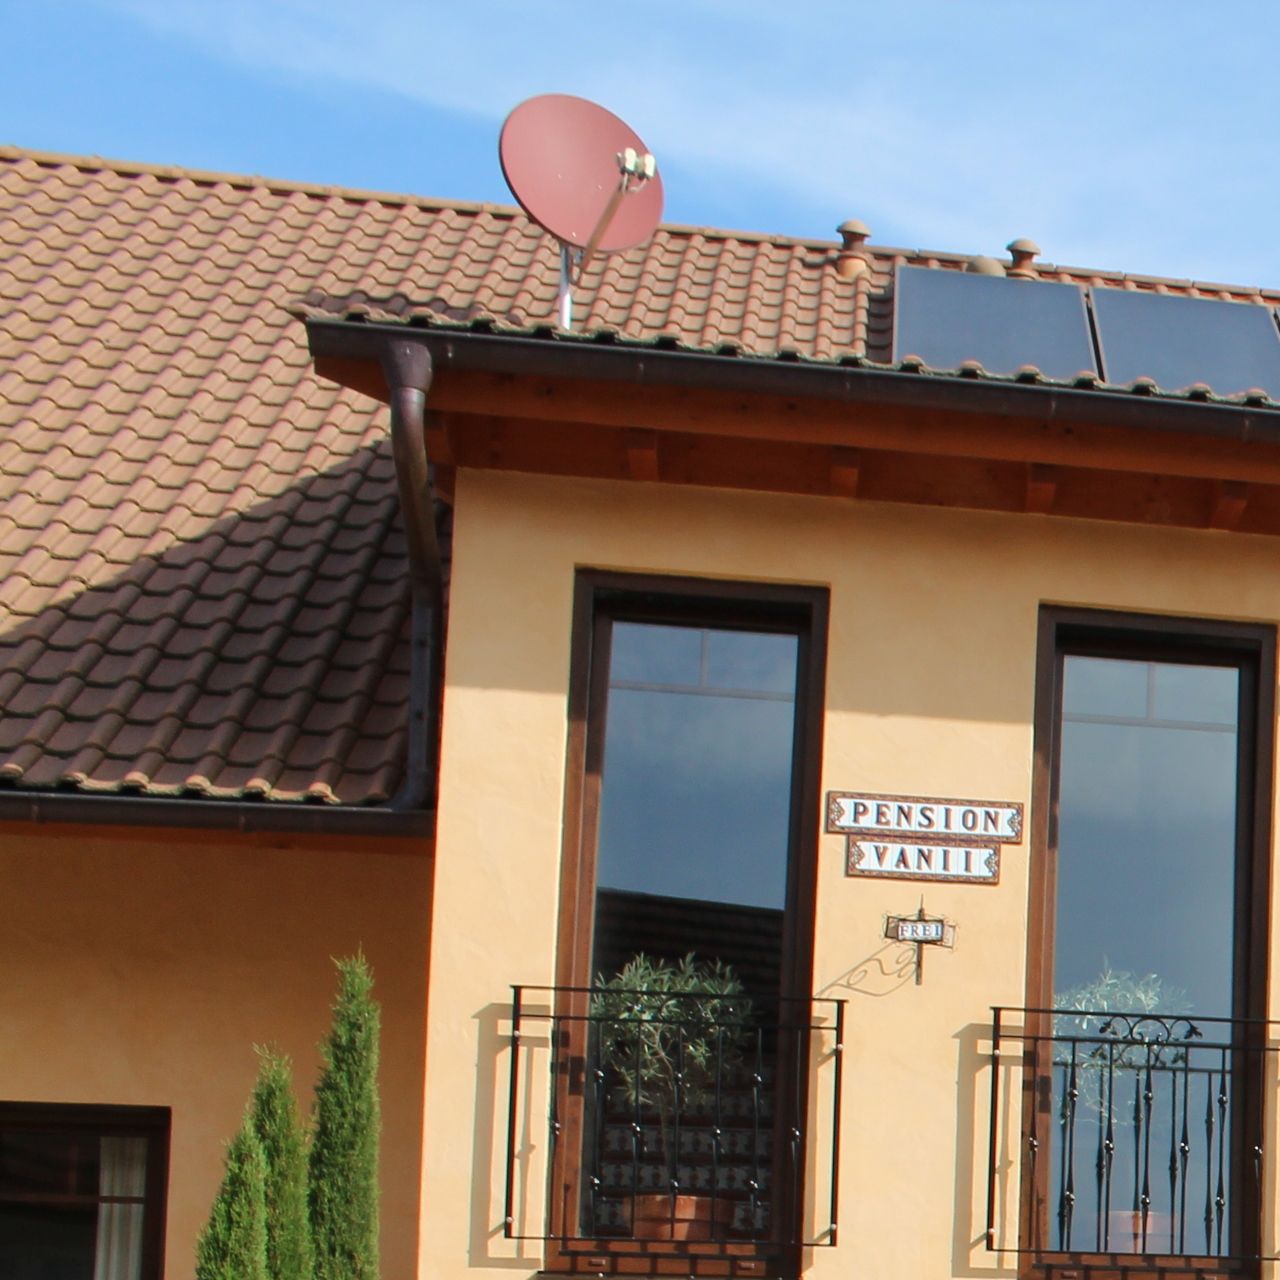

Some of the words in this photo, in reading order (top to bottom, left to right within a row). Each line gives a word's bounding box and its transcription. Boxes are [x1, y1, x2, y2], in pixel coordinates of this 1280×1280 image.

[852, 801, 1001, 832] PENSION
[873, 845, 974, 873] VANII
[900, 924, 940, 937] FREI
